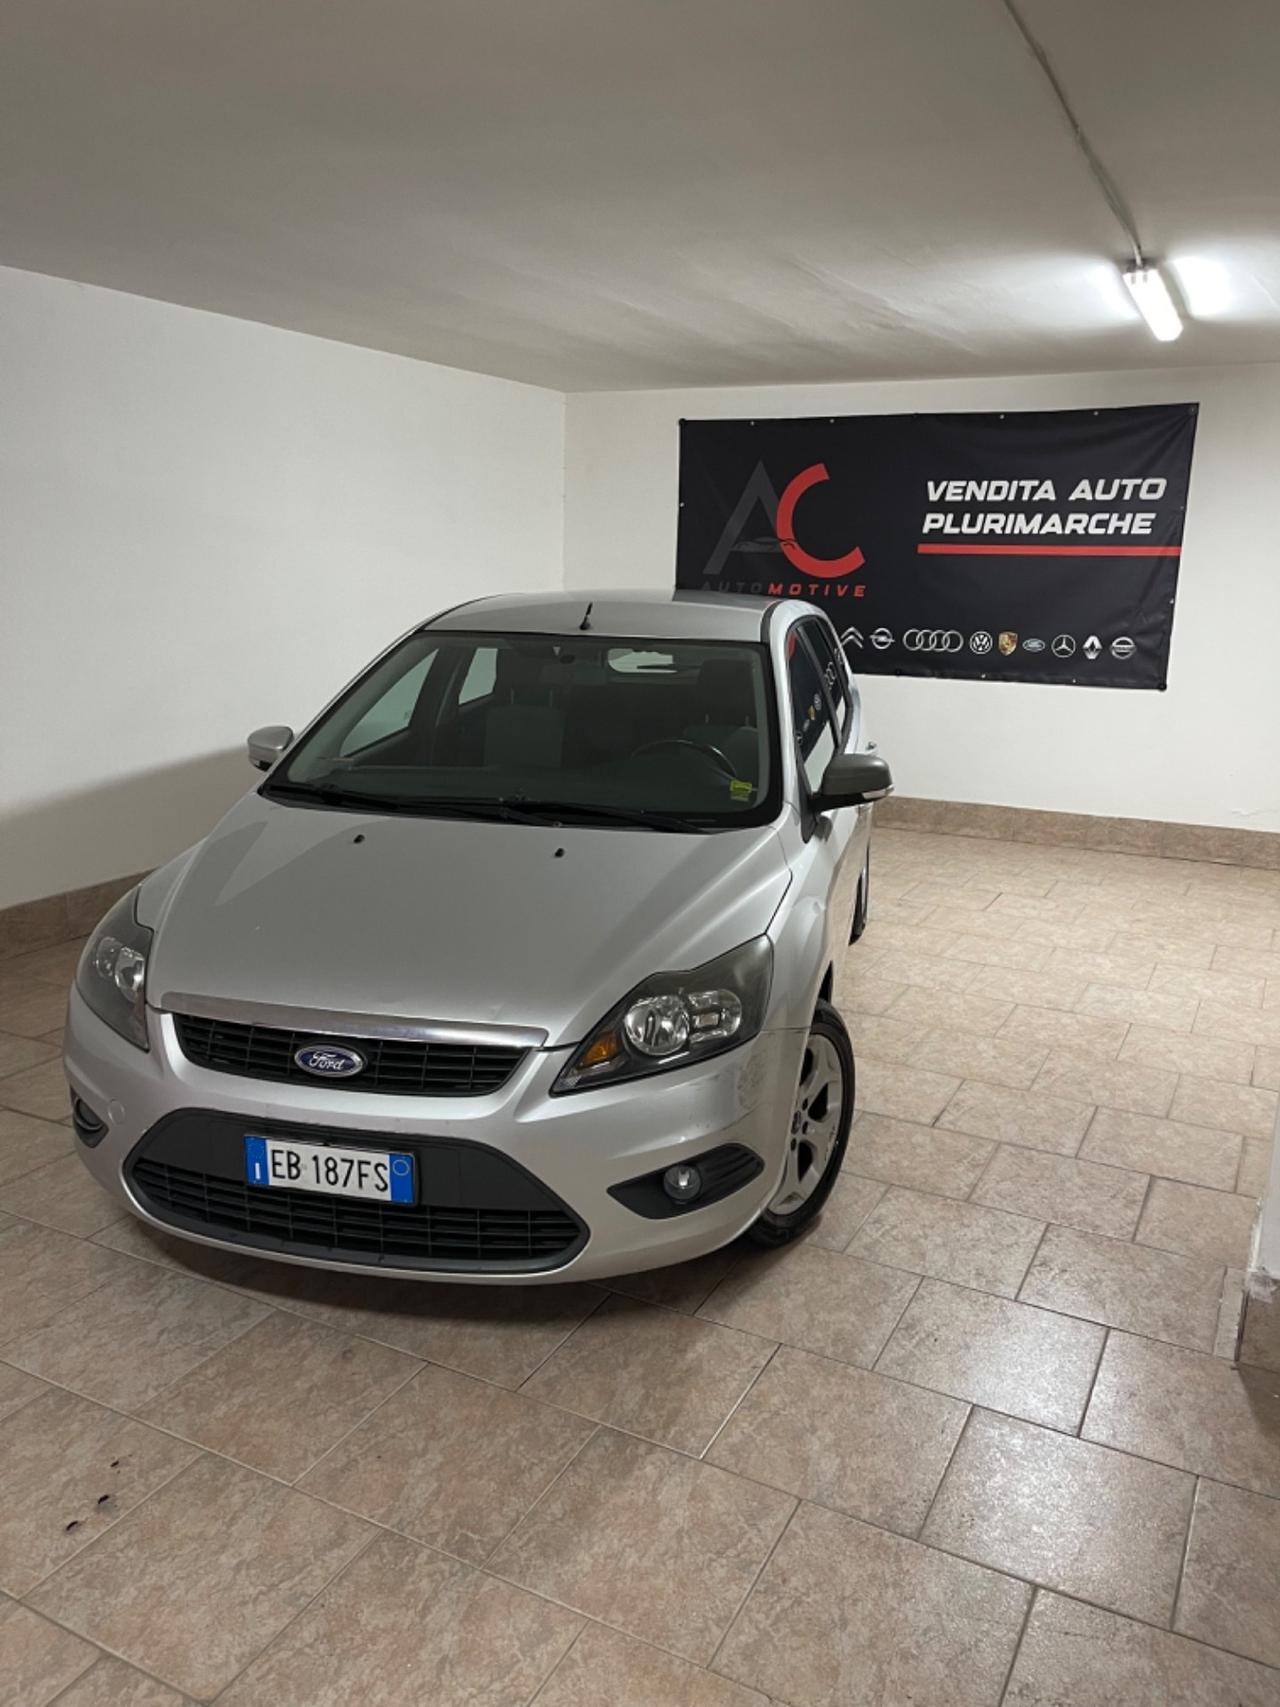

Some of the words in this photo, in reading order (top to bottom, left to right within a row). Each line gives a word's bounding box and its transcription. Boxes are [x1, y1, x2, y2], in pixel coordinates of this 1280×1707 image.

[926, 479, 1057, 502] VENDITA
[1068, 477, 1168, 501] AUTO
[921, 512, 1157, 535] PLURIMARCHE
[309, 1051, 345, 1071] Ford
[271, 1149, 301, 1181] EB
[312, 1154, 389, 1192] 187FS
